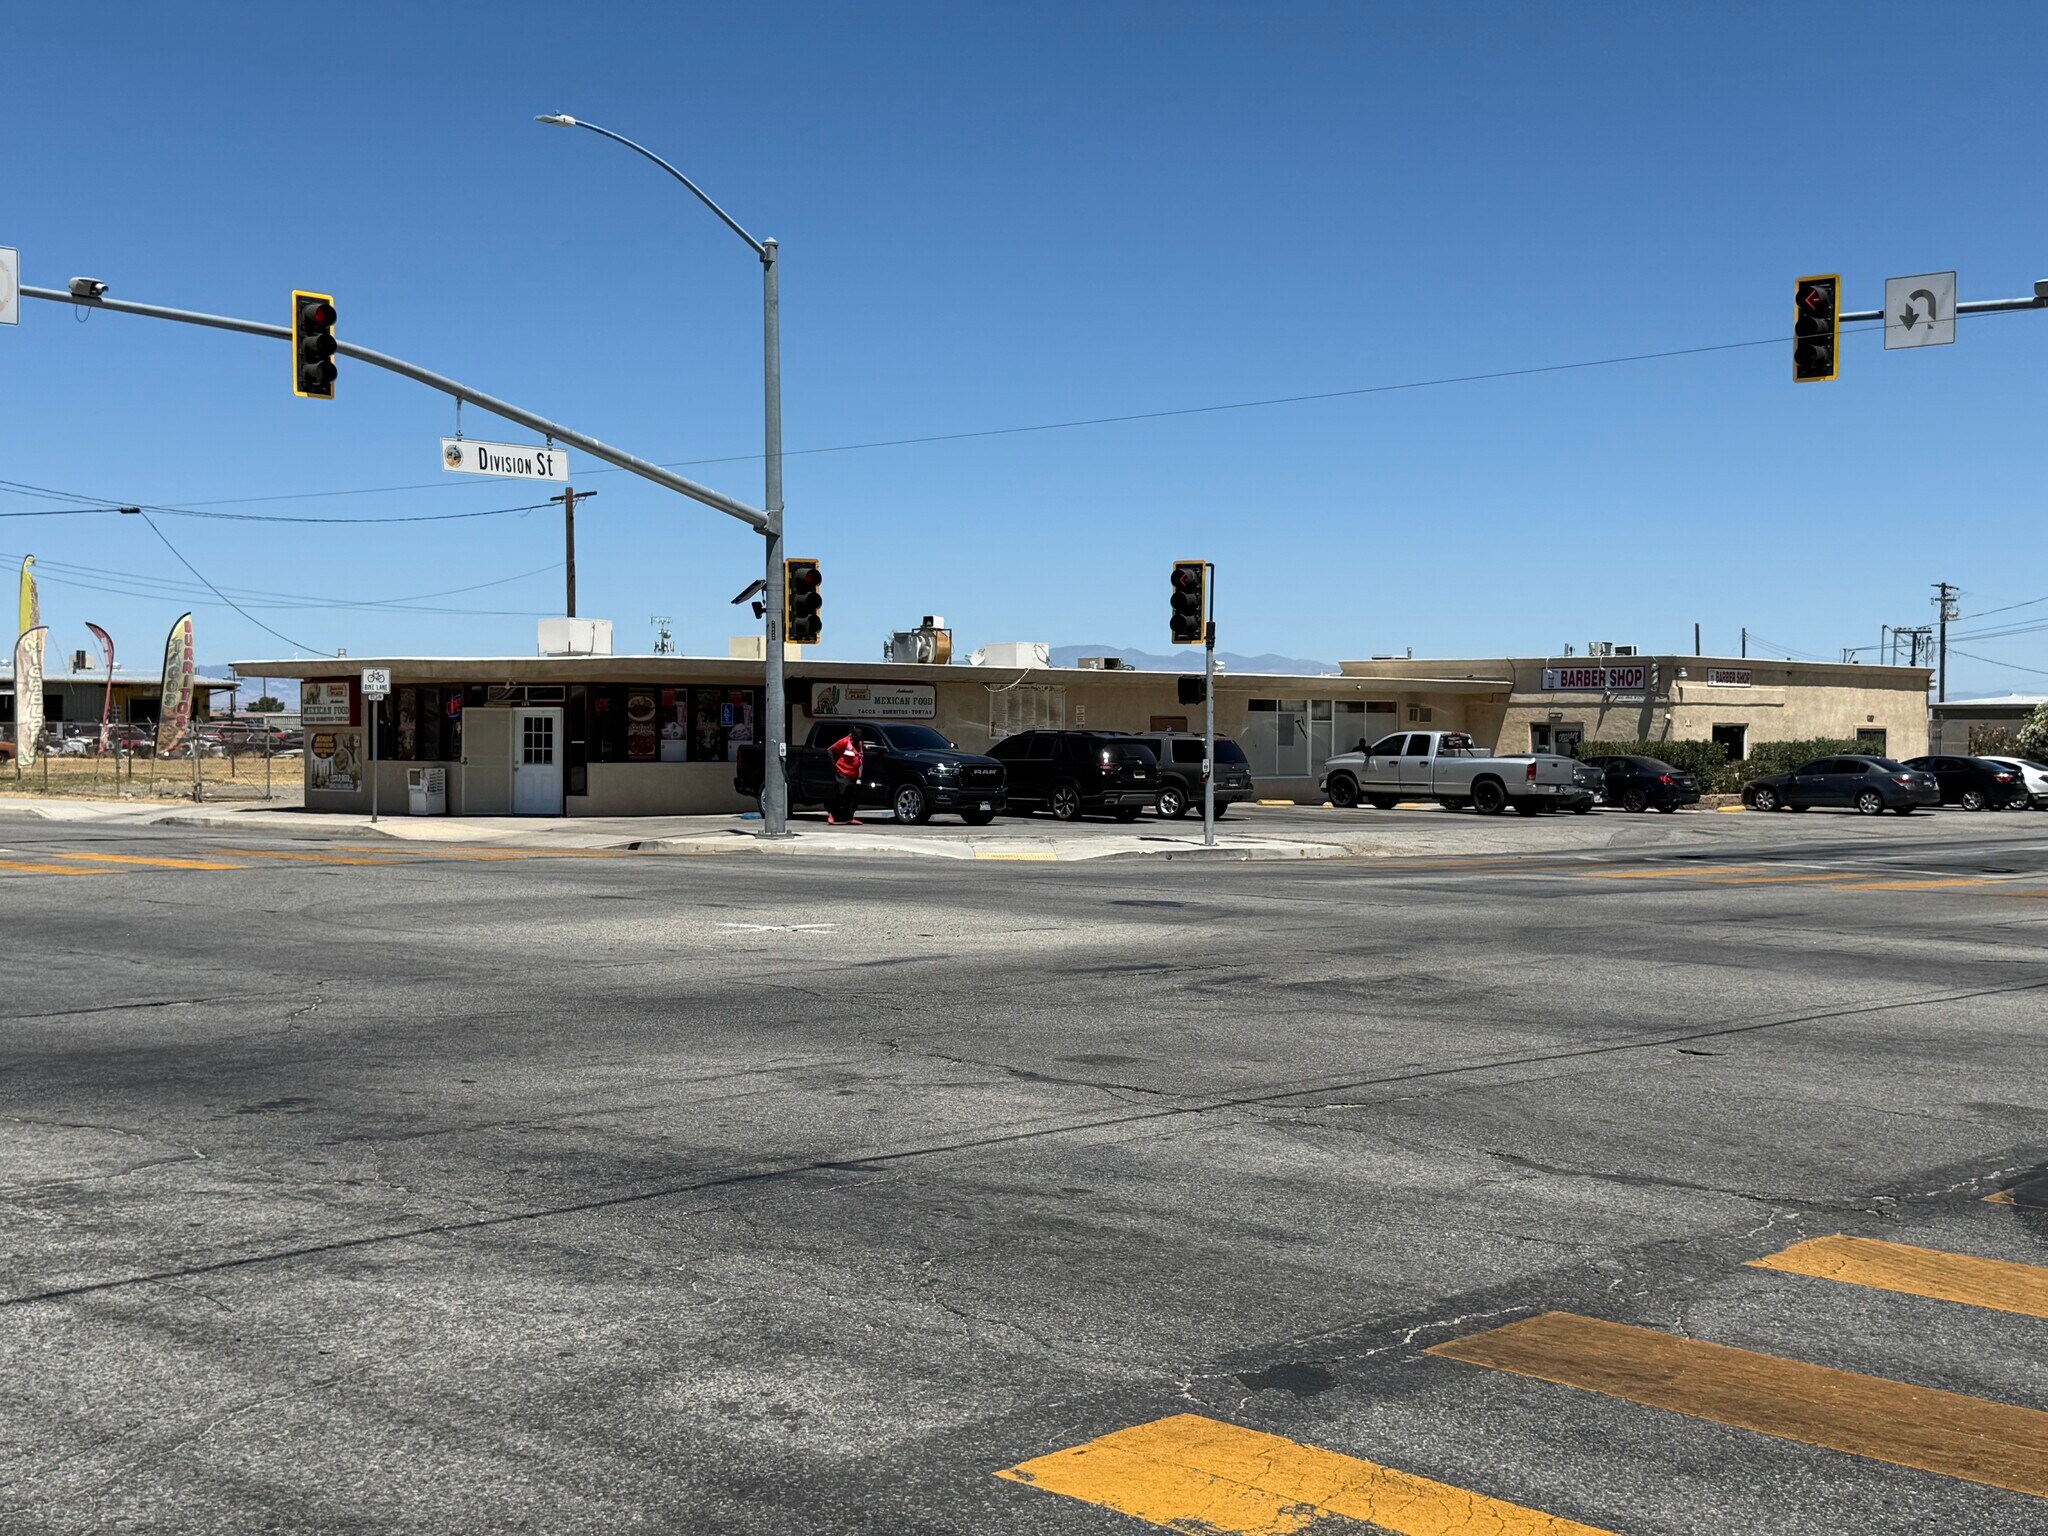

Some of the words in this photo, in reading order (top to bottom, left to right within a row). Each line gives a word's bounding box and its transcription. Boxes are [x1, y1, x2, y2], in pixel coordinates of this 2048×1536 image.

[536, 452, 553, 476] St
[164, 637, 183, 707] TACOS
[175, 620, 194, 728] BURRITOS
[1560, 669, 1606, 687] BARBER
[1609, 669, 1642, 687] SHOP
[1715, 670, 1736, 684] BARBER
[1736, 671, 1751, 684] SHOP
[874, 696, 911, 705] MEXICAN
[913, 697, 933, 706] FOOD
[303, 706, 332, 715] MEXICAN
